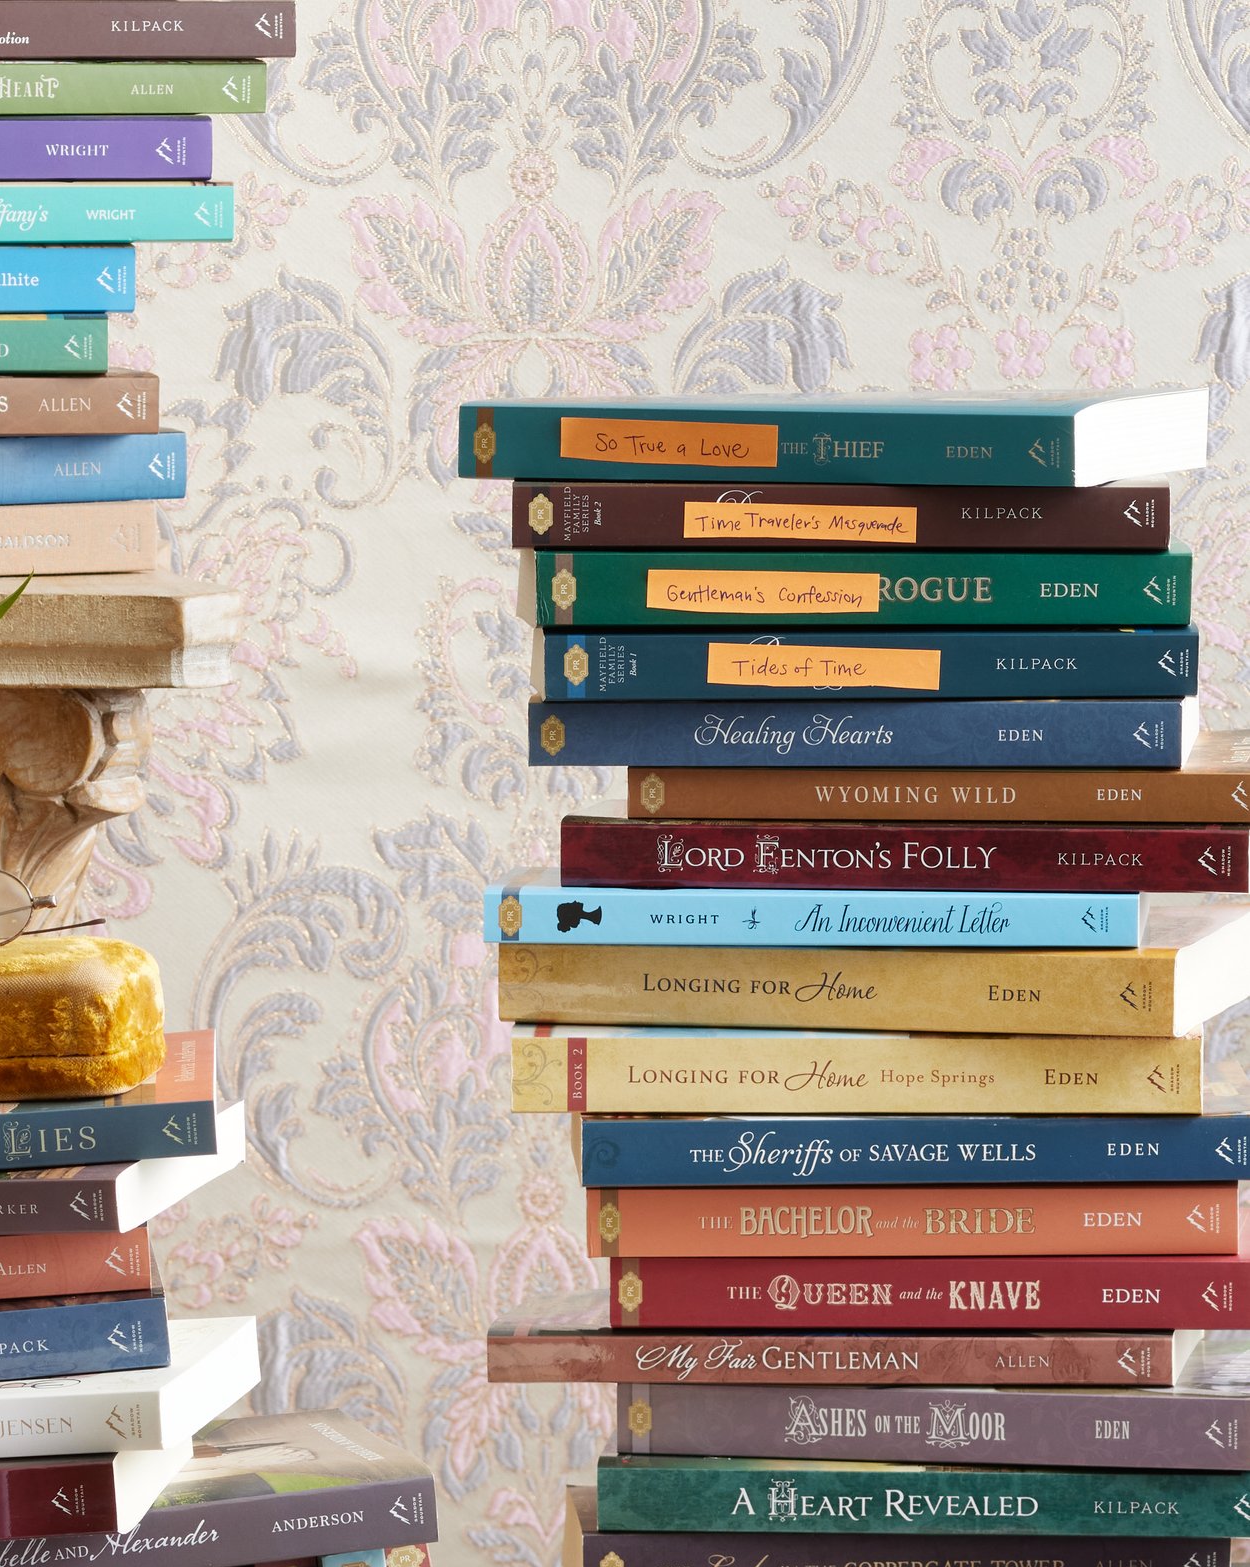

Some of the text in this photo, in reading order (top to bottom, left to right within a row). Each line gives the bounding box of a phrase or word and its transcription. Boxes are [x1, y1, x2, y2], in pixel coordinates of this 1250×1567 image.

[111, 21, 183, 31] KILPACK
[131, 83, 173, 95] ALLEN
[46, 144, 108, 156] WRIGHT
[86, 208, 136, 224] WRIGHT
[39, 398, 90, 411] ALLEN
[596, 433, 617, 451] So
[624, 436, 666, 455] True
[701, 439, 749, 458] Love
[580, 494, 590, 532] SERIES
[593, 508, 602, 526] Book
[962, 508, 1042, 519] KILPACK
[695, 516, 741, 531] Time
[667, 585, 862, 607] Gentleman's Confession
[1041, 583, 1098, 597] EDEN
[732, 657, 866, 677] Tides of Time
[997, 658, 1077, 669] KILPACK
[695, 714, 893, 754] Healing Hearts
[998, 730, 1043, 741] EDEN
[815, 786, 1015, 803] WYOMING WILD
[1098, 789, 1141, 800] EDEN
[1058, 853, 1142, 866] KILPACK
[650, 915, 719, 924] WRIGHT
[795, 903, 1008, 934] An Inconvenient Letter
[795, 972, 877, 1002] Home
[573, 1064, 582, 1098] BOOK
[784, 1060, 868, 1091] Home
[882, 1070, 924, 1087] Hope
[931, 1070, 994, 1088] Springs
[690, 1131, 1035, 1176] THE Sheriffs OF SAVAGE WELLS
[1108, 1143, 1158, 1155] EDEN
[740, 1206, 1034, 1239] BACHELOR BRIDE
[1084, 1213, 1142, 1226] EDEN
[727, 1280, 1039, 1310] THE KNAVE
[1102, 1289, 1160, 1303] EDEN
[636, 1344, 917, 1375] My Fair GENTLEMAN
[731, 1488, 755, 1515] A
[1094, 1501, 1179, 1514] KILPACK
[272, 1511, 363, 1532] ANDERSON
[89, 1519, 219, 1561] Alexander
